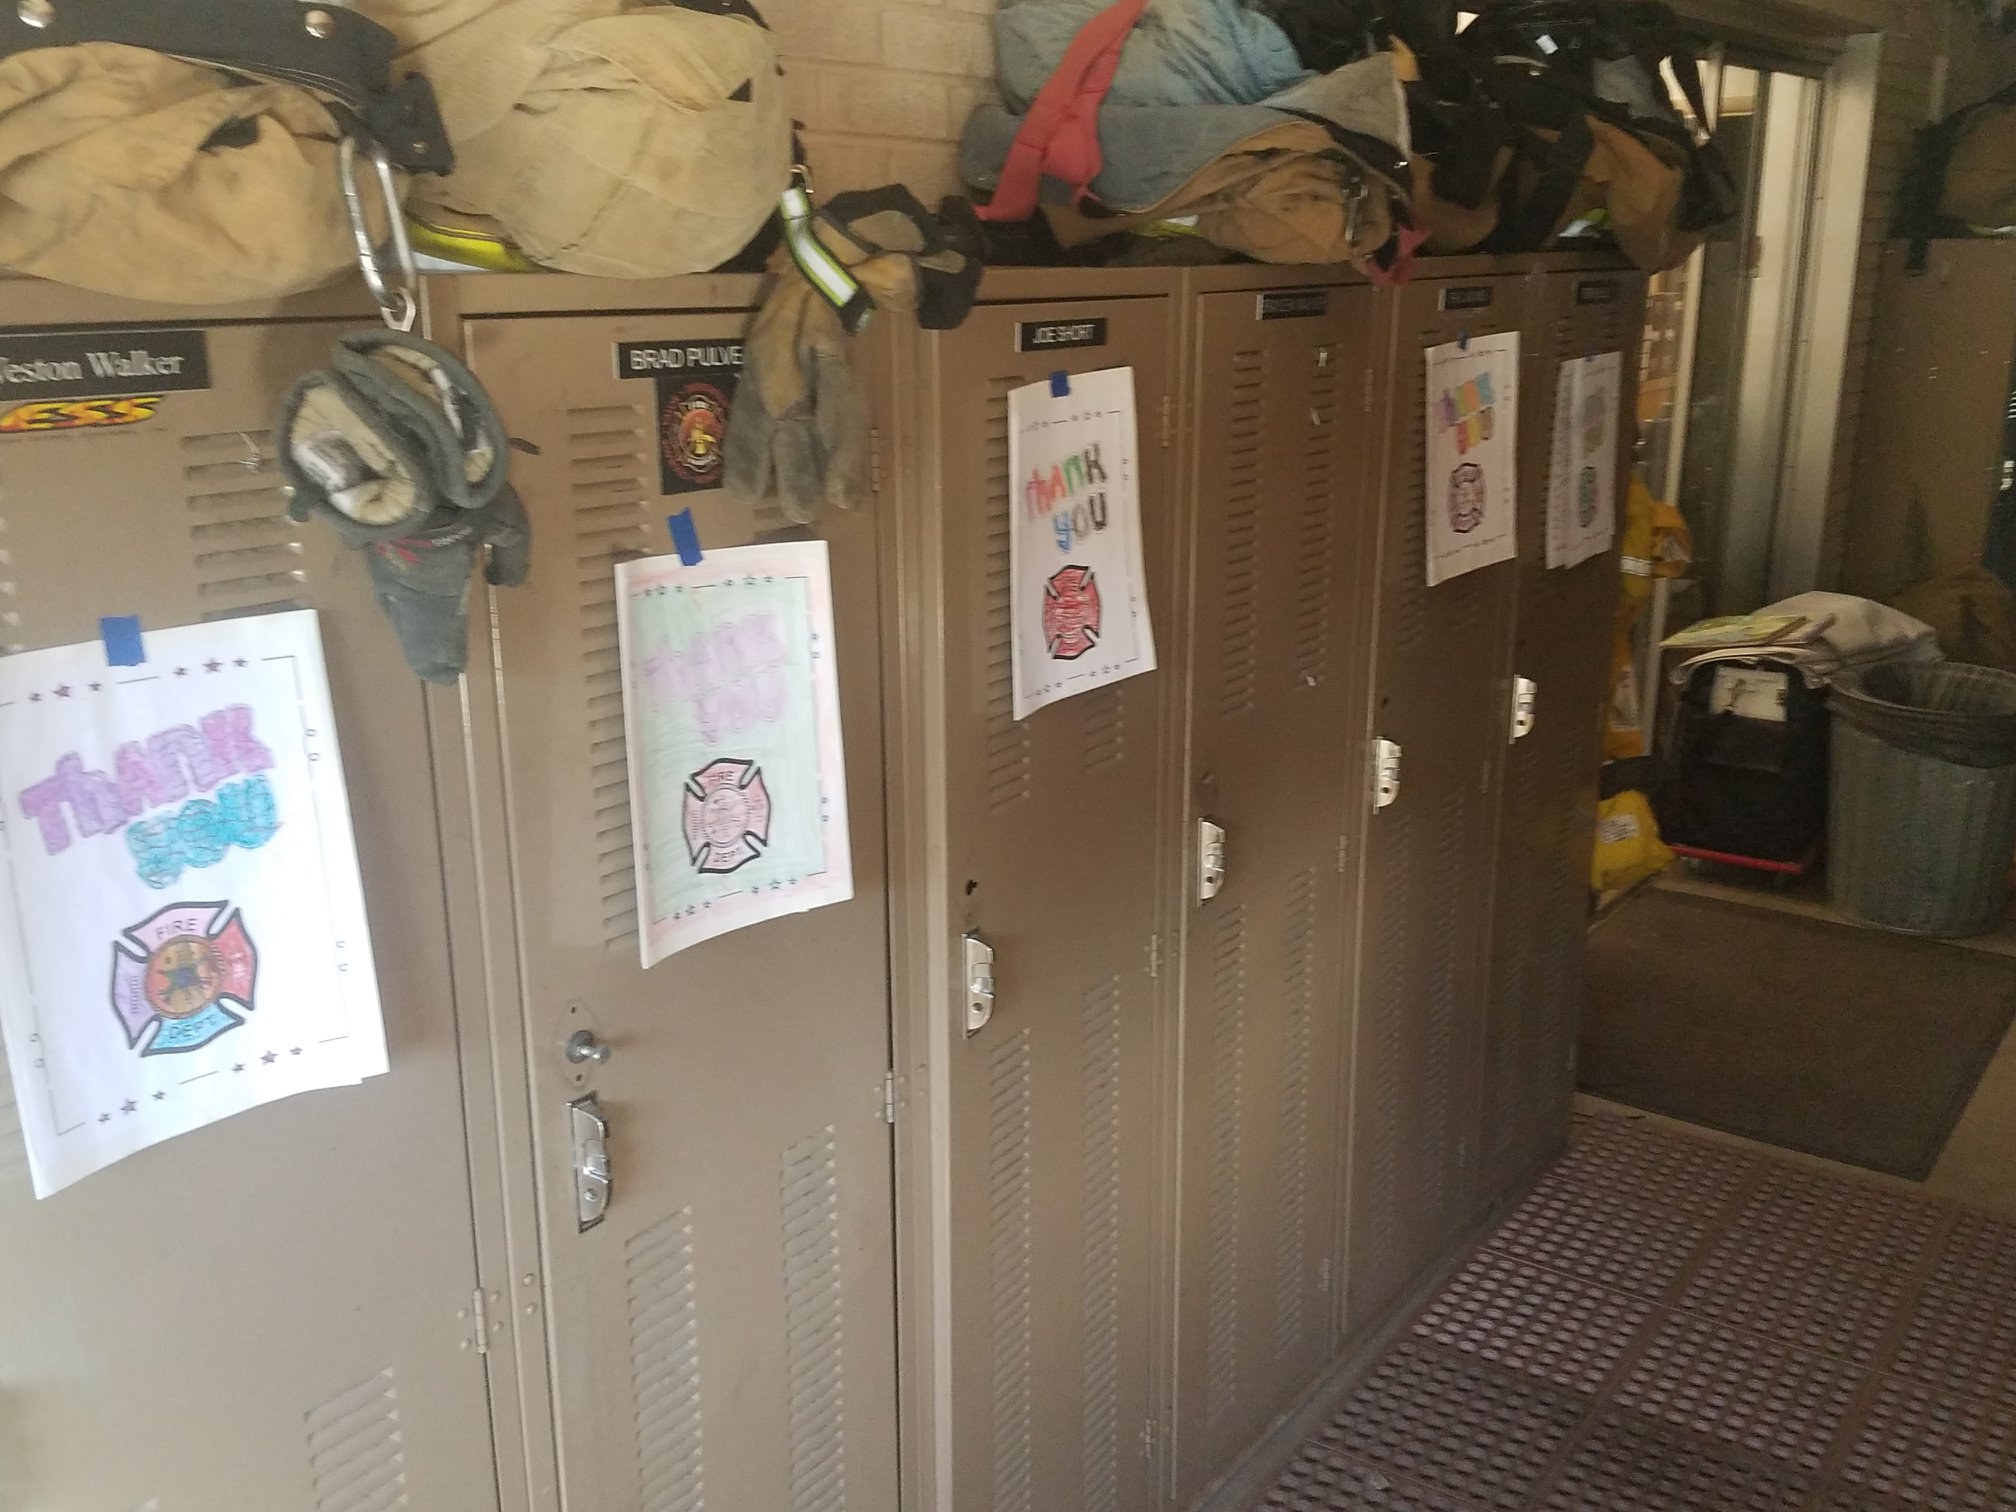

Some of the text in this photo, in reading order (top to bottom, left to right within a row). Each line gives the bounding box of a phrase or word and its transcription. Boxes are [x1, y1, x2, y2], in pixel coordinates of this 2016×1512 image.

[1032, 327, 1057, 343] JOE
[0, 350, 185, 385] eston Walker
[630, 348, 686, 370] BRAD
[155, 918, 198, 940] FIRE
